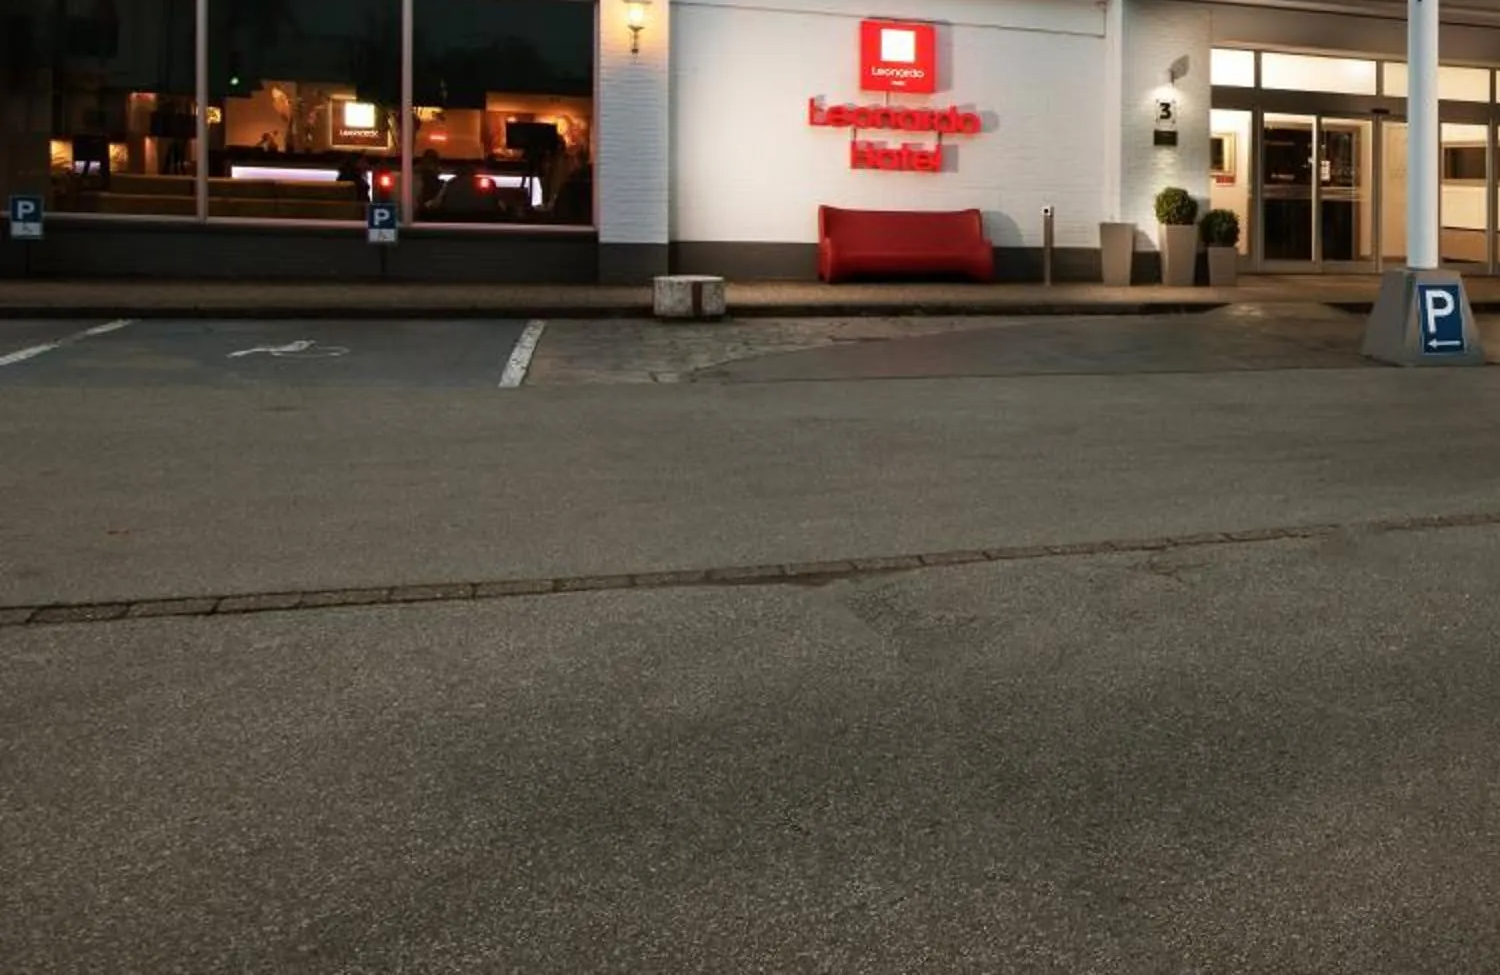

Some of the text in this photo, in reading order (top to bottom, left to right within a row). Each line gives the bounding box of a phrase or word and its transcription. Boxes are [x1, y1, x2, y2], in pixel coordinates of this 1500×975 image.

[809, 97, 982, 134] Leonardo
[1159, 102, 1172, 120] 3
[851, 140, 943, 172] Hotel
[17, 200, 35, 220] P
[373, 208, 390, 226] P
[1425, 289, 1455, 333] P
